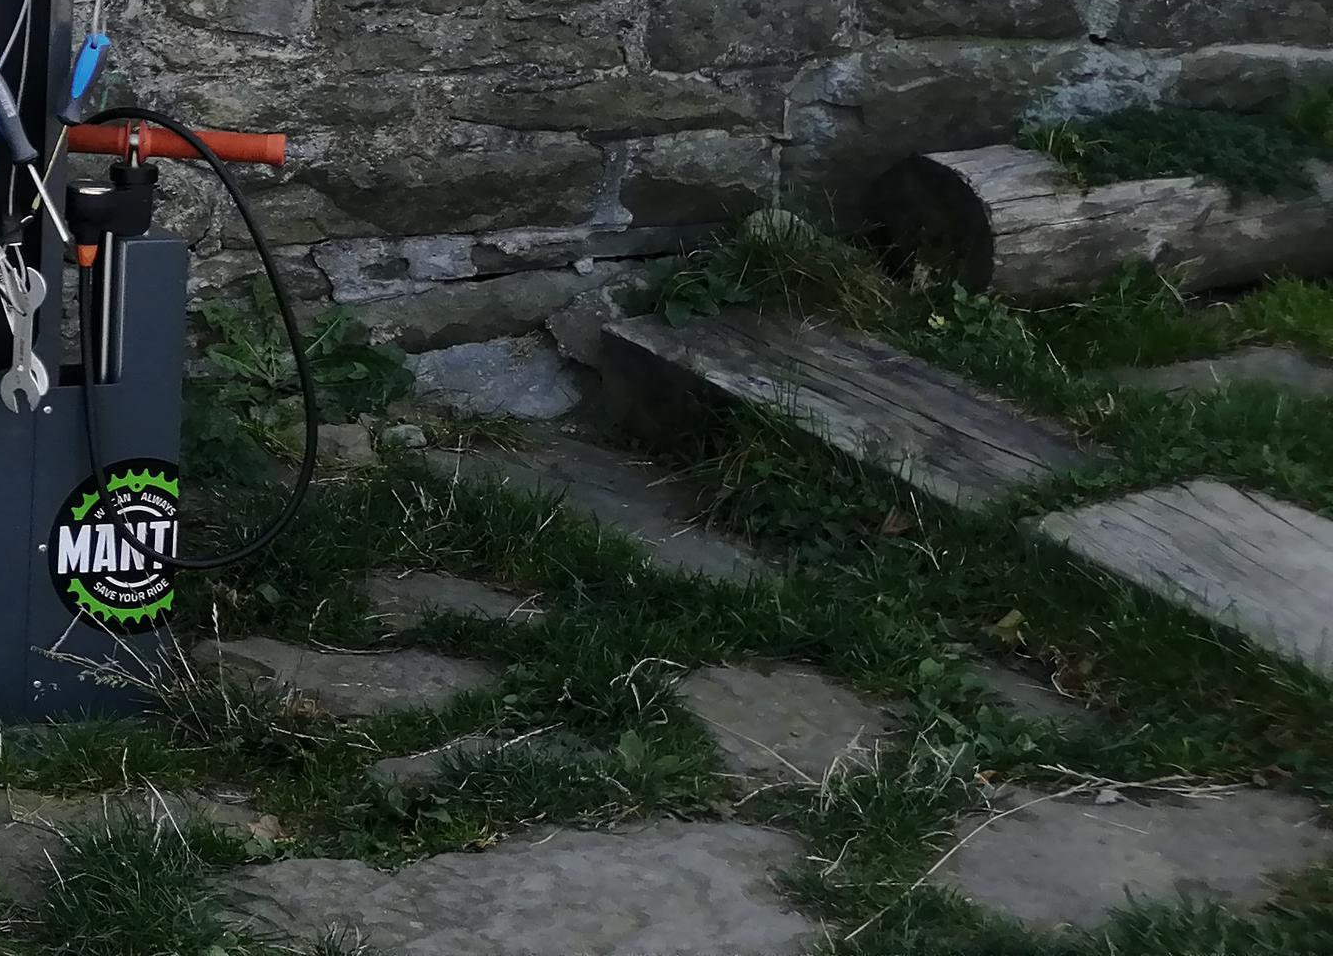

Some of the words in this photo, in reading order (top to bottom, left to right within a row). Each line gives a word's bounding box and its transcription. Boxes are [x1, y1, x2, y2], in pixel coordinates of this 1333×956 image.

[140, 492, 176, 516] ALWAYS
[93, 581, 117, 601] SAVE
[118, 589, 146, 603] YOUR
[146, 578, 170, 597] RIDE
